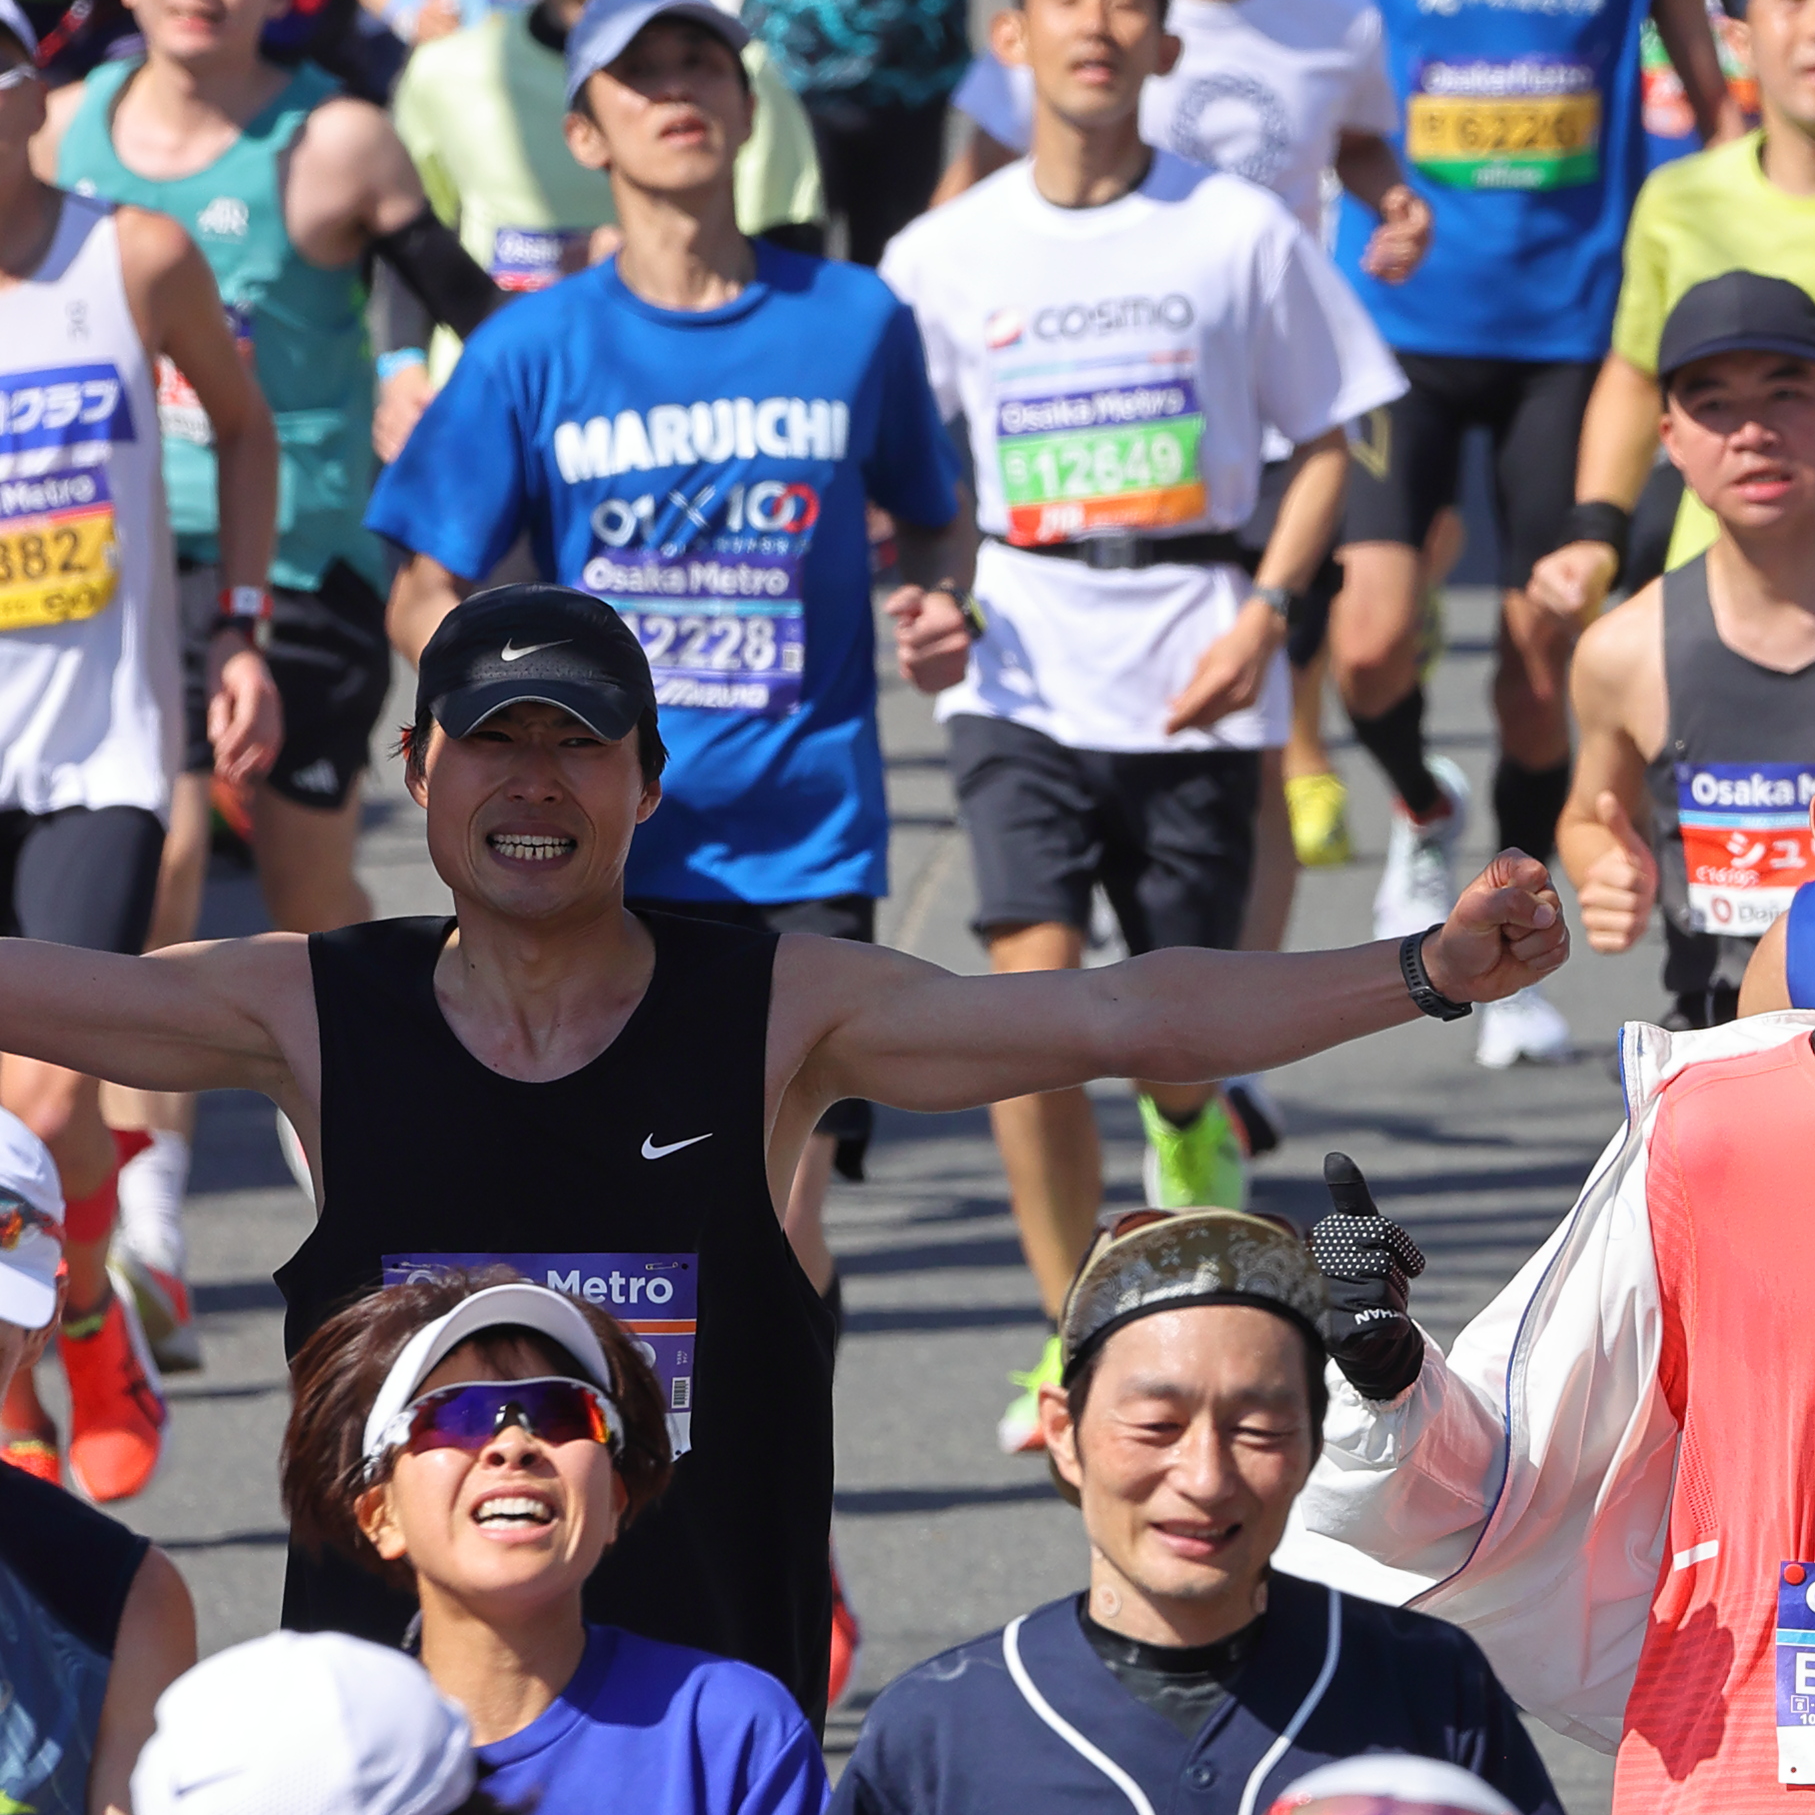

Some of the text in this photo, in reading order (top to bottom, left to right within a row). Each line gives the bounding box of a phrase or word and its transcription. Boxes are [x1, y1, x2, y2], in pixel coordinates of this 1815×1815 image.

[0, 379, 119, 434] クラブ
[1001, 394, 1093, 434] Osaka
[554, 396, 849, 484] MARUICHI
[1036, 432, 1185, 498] 12649
[1, 473, 97, 515] Metro
[582, 556, 790, 595] Osaka Metro
[1691, 771, 1796, 807] Osaka
[547, 1269, 674, 1305] Metro
